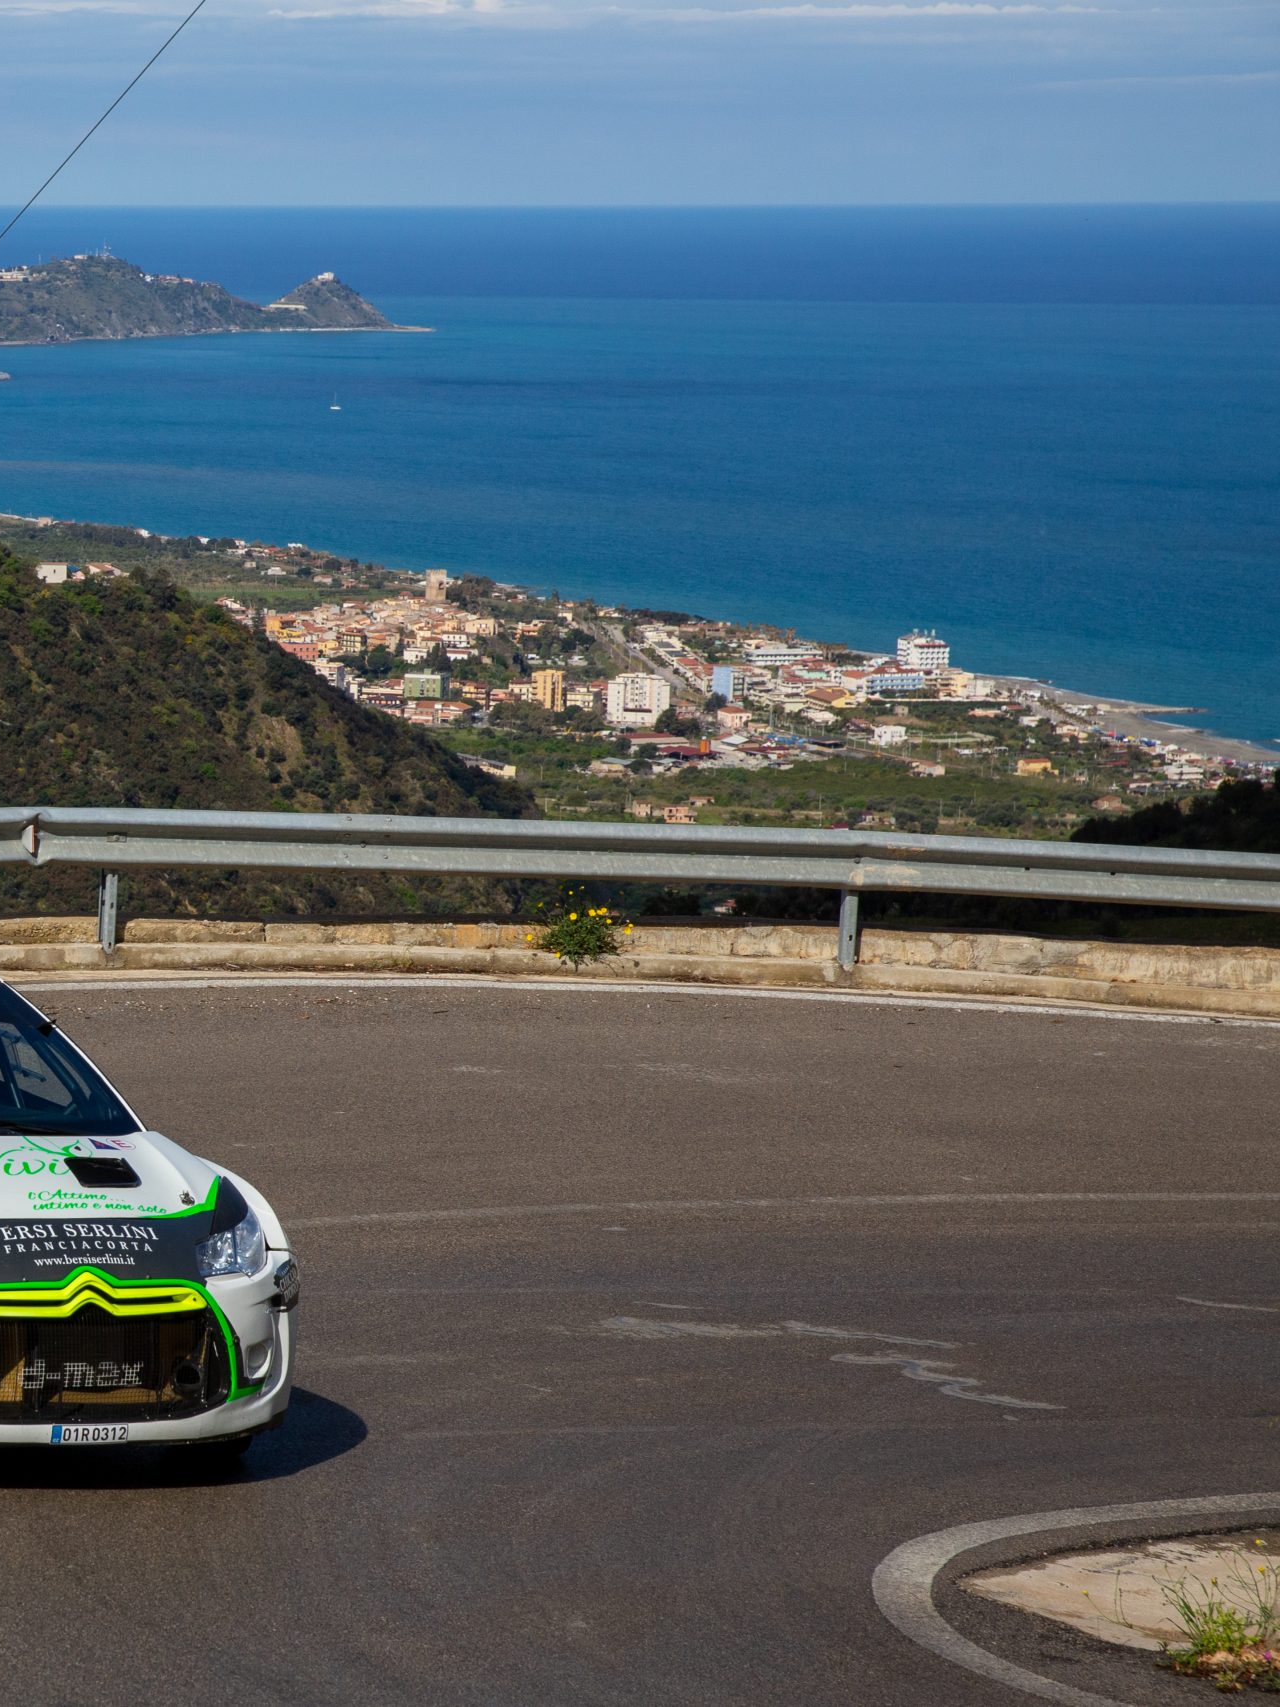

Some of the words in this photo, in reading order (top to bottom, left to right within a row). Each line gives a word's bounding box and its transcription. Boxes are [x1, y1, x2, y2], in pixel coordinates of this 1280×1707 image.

[105, 1203, 134, 1211] non
[137, 1205, 167, 1214] solo
[62, 1223, 159, 1240] SERLINI
[3, 1240, 153, 1254] FRANCIACORTA
[34, 1253, 135, 1266] www.bersiserlini.it
[17, 1359, 143, 1389] d-max
